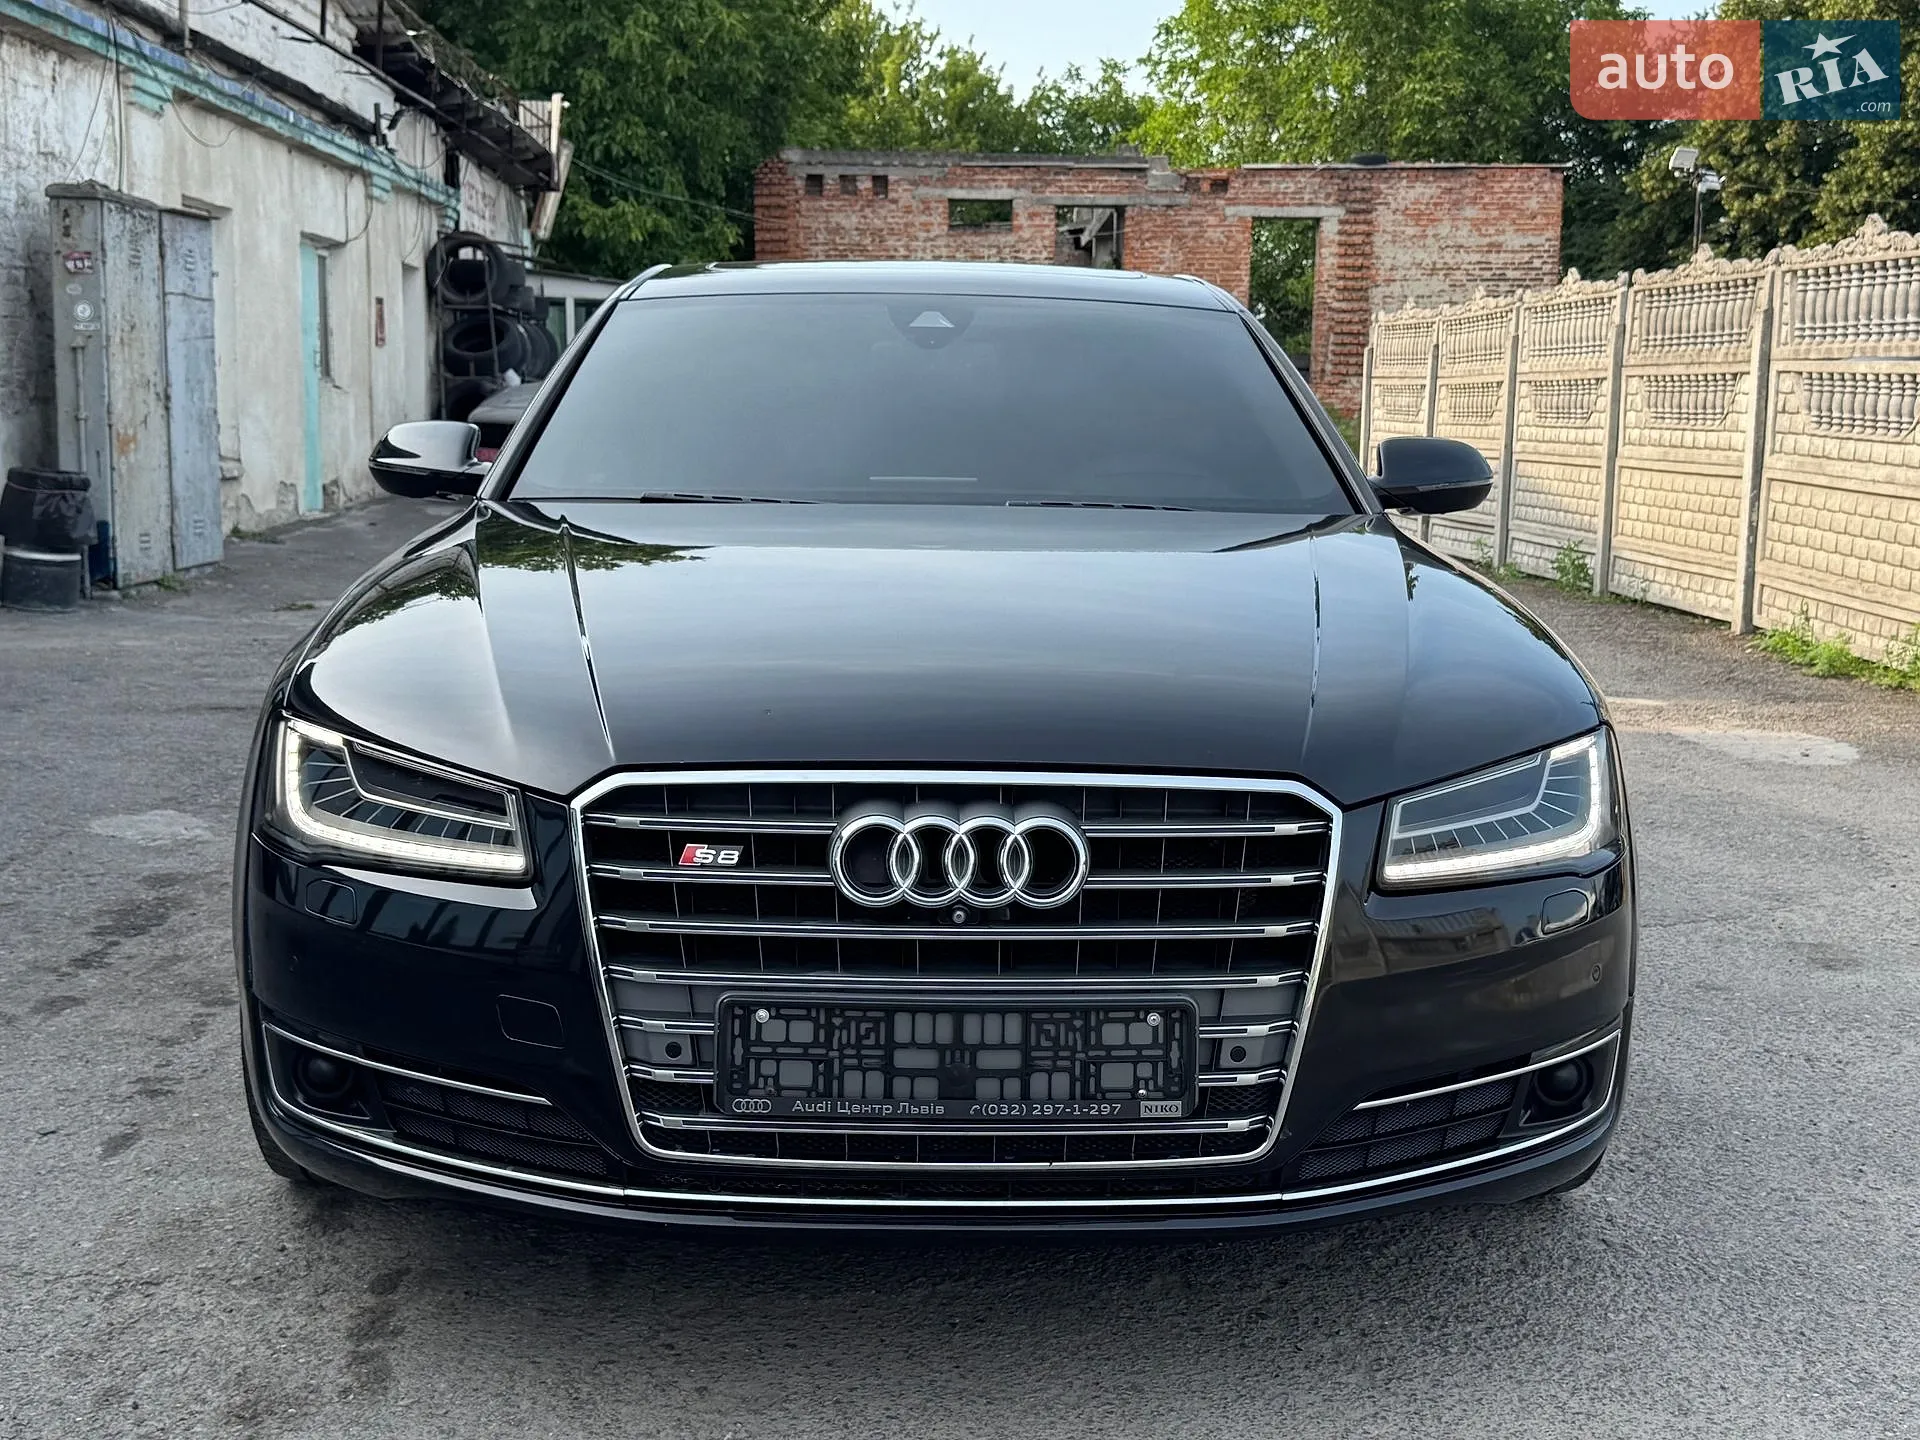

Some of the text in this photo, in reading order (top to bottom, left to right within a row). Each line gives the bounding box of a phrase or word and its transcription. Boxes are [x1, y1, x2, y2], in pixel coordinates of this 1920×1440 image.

[692, 848, 740, 865] S8
[791, 1100, 1122, 1116] Audi Центр Львів (032) 297-1-297
[1143, 1103, 1180, 1115] NIKO
